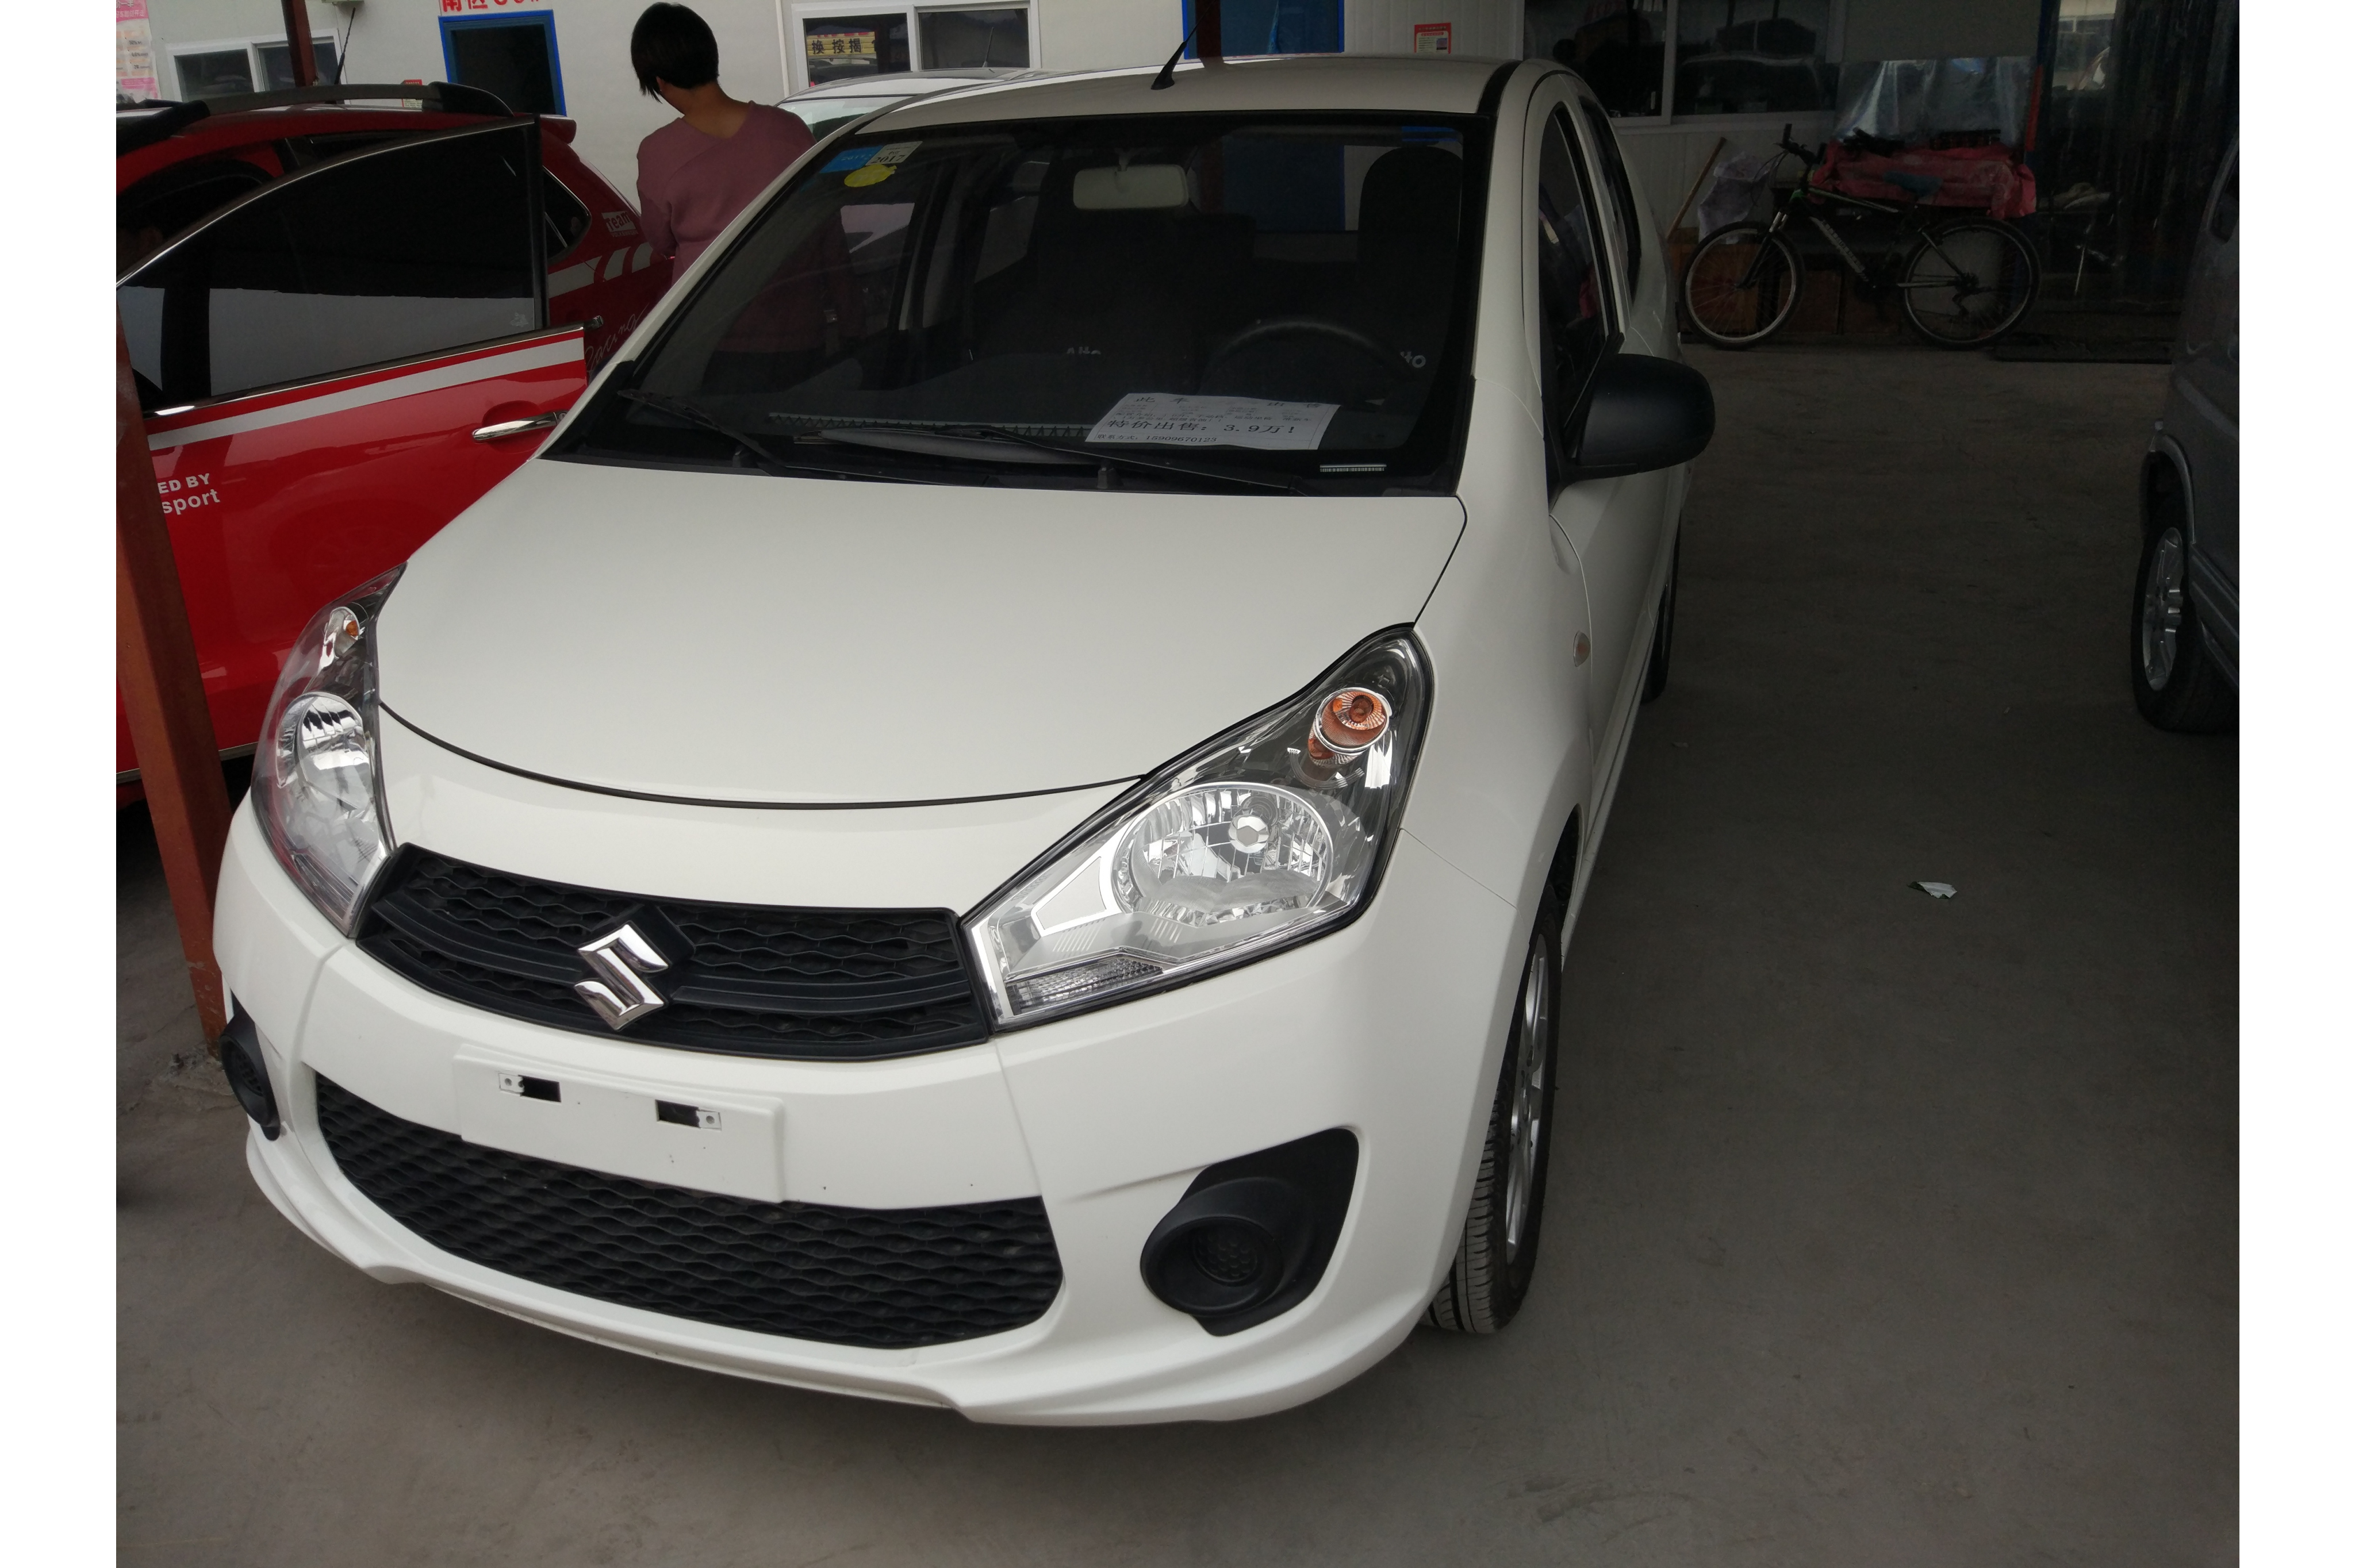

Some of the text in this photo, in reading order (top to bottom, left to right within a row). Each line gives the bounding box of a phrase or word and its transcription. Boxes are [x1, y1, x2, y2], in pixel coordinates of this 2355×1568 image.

[870, 155, 906, 164] 2017
[157, 473, 209, 494] ED BY
[162, 489, 220, 515] sport
